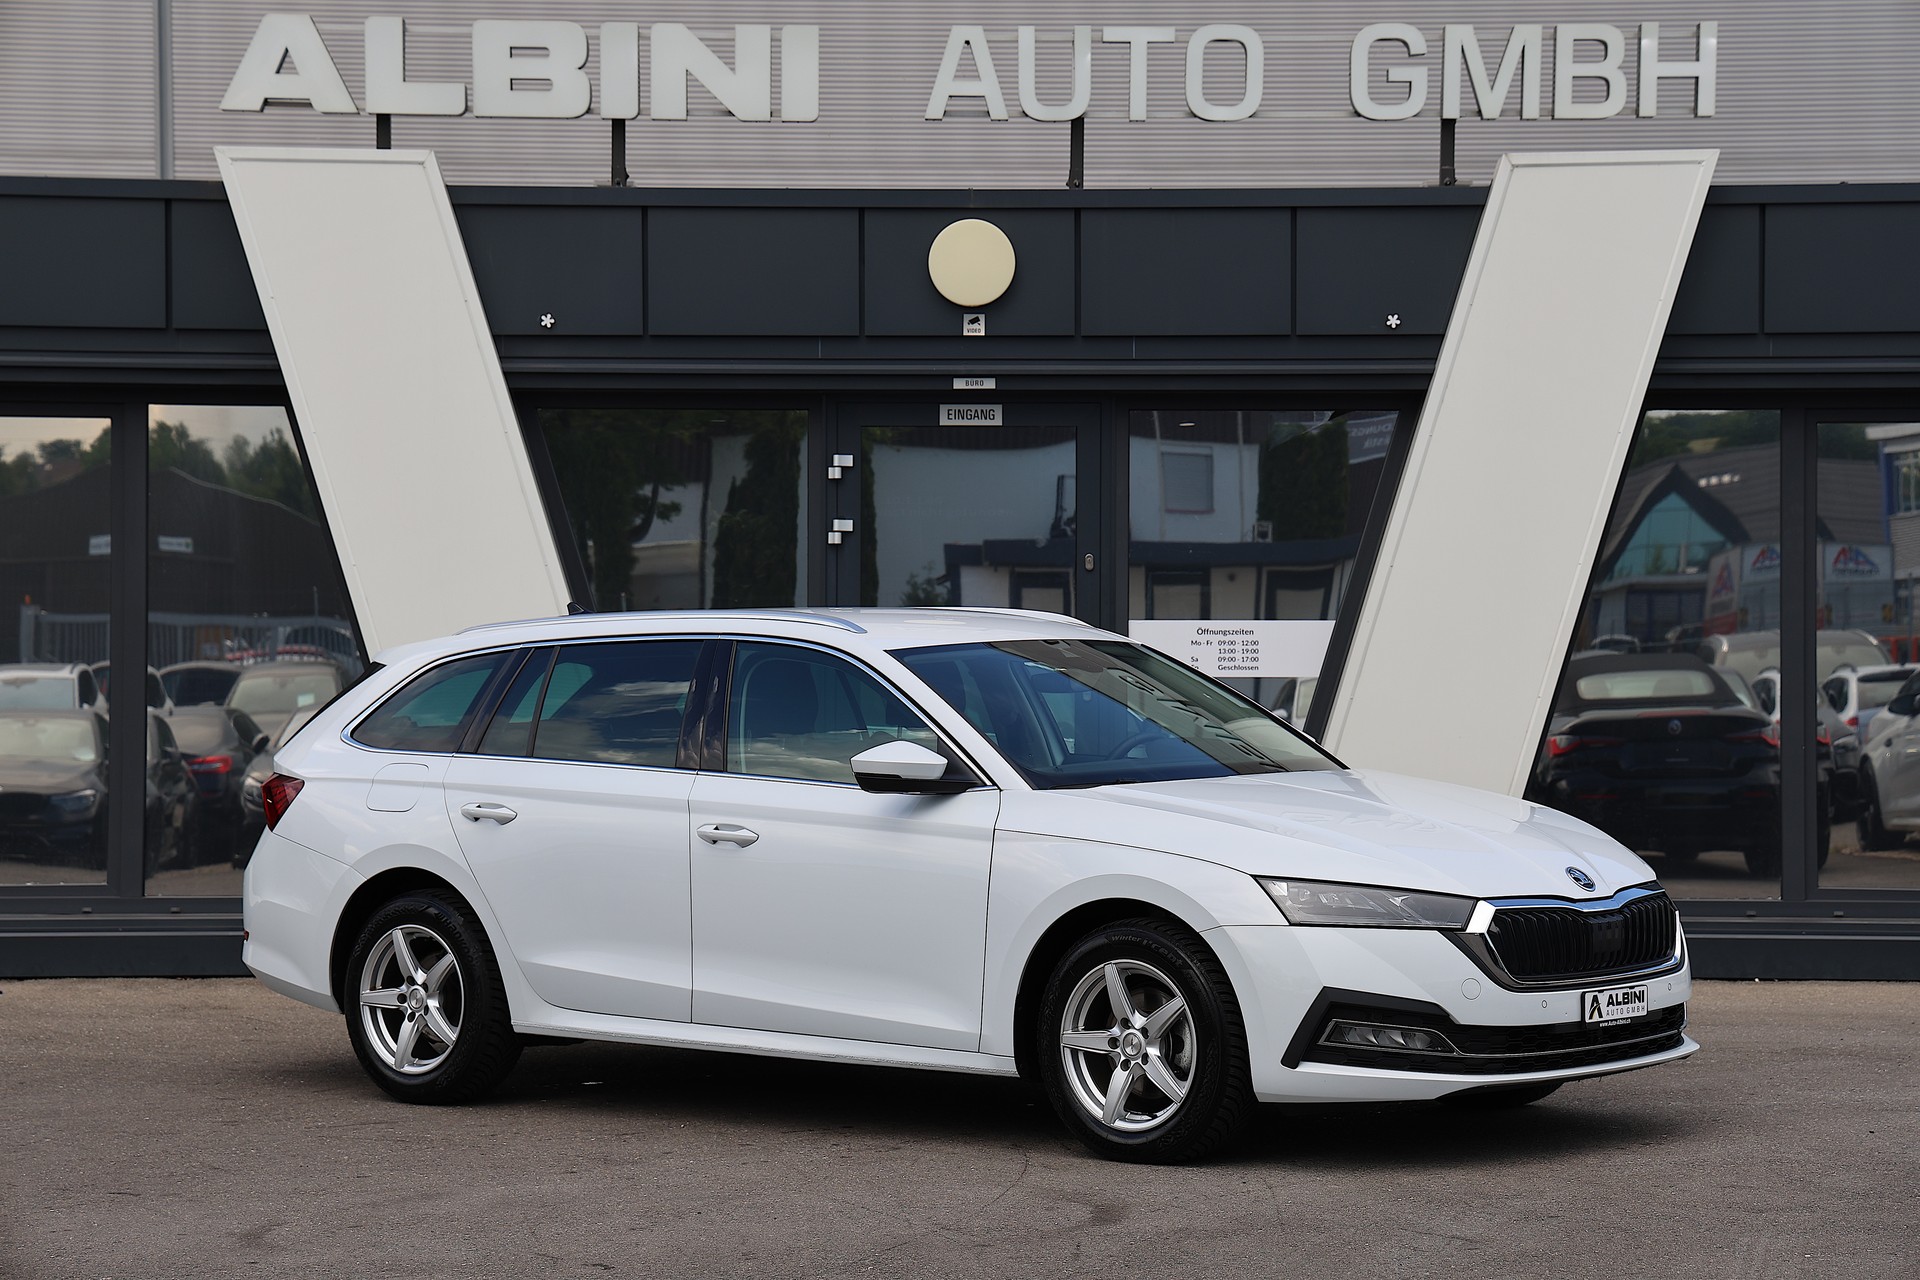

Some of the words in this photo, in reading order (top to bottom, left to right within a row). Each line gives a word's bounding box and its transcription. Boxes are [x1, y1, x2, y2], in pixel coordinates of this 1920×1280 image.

[219, 13, 820, 123] ALBINI
[925, 23, 1265, 122] AUTO
[1349, 20, 1719, 121] GMBH
[947, 408, 996, 421] EINGANG
[1196, 627, 1254, 636] Öffnungszeiten
[1606, 990, 1645, 1007] ALBINI
[1606, 1008, 1623, 1017] AUTO
[1627, 1005, 1645, 1014] GMBH
